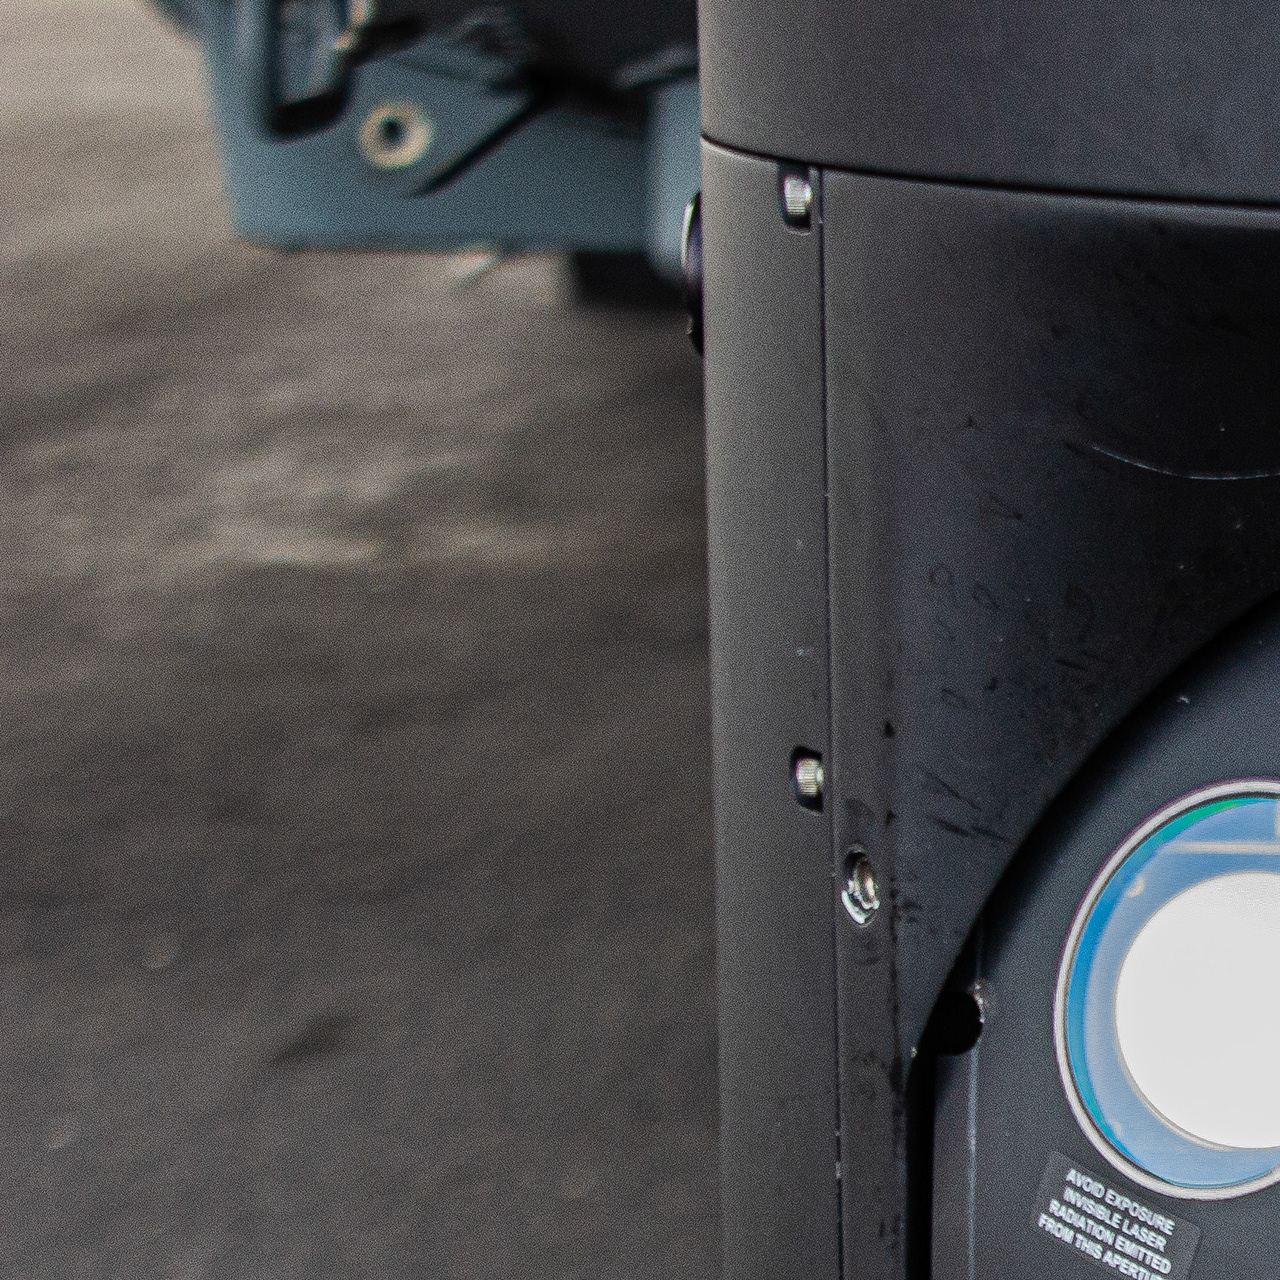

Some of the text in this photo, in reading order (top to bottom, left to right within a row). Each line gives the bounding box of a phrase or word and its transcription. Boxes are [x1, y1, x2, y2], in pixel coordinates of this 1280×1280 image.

[1063, 1186, 1167, 1253] INVISIBLE LASER
[1065, 1168, 1176, 1236] AVOID EXPOSURE
[1037, 1212, 1075, 1245] FROM
[1074, 1232, 1104, 1260] THIS
[1049, 1198, 1172, 1275] RADIATION EMITTED
